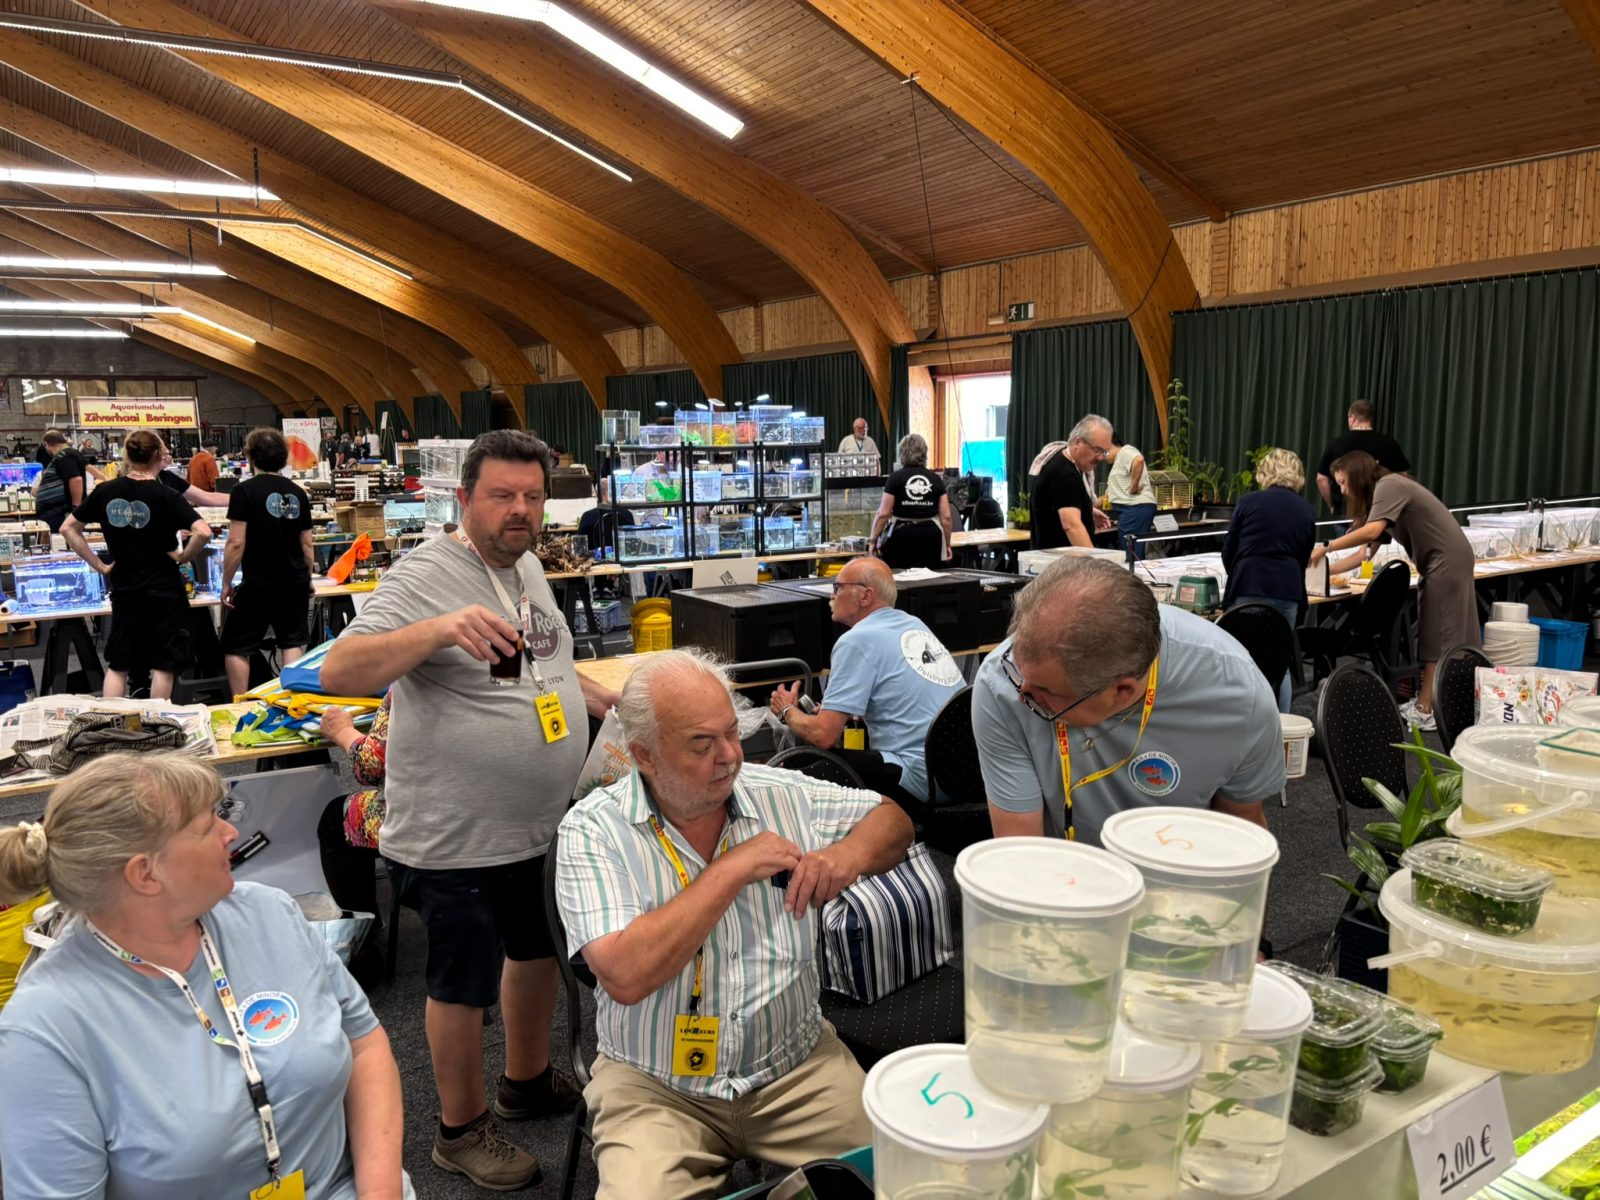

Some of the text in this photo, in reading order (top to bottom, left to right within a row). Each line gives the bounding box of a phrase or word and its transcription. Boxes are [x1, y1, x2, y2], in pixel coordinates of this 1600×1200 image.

[110, 403, 165, 411] Aquariumclub
[84, 412, 193, 424] Zilverhaai Beringen
[531, 638, 552, 650] CAFE
[547, 675, 564, 685] LYON
[1155, 824, 1194, 850] 5
[256, 991, 281, 999] MINOR
[920, 1071, 974, 1120] 5
[1437, 1124, 1493, 1187] 2,00 €
